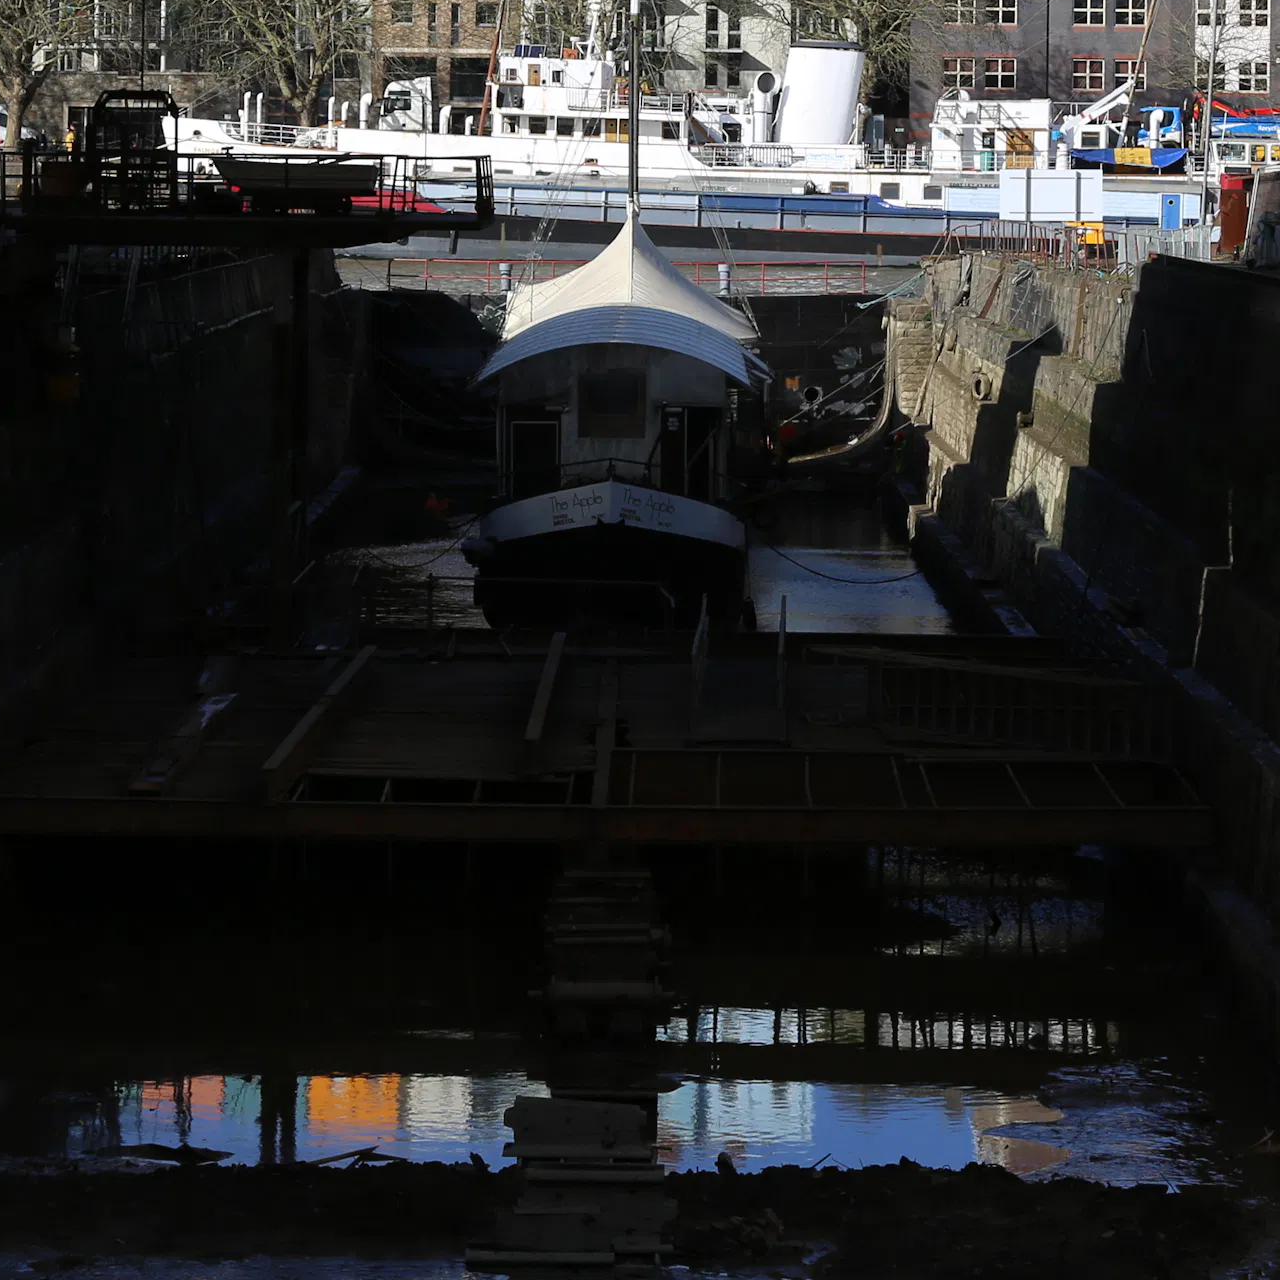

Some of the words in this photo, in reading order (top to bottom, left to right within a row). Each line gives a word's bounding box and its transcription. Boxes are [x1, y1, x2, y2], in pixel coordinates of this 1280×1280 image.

[549, 496, 569, 513] The
[572, 488, 603, 518] Apple
[624, 487, 642, 507] The
[643, 493, 676, 521] Apple
